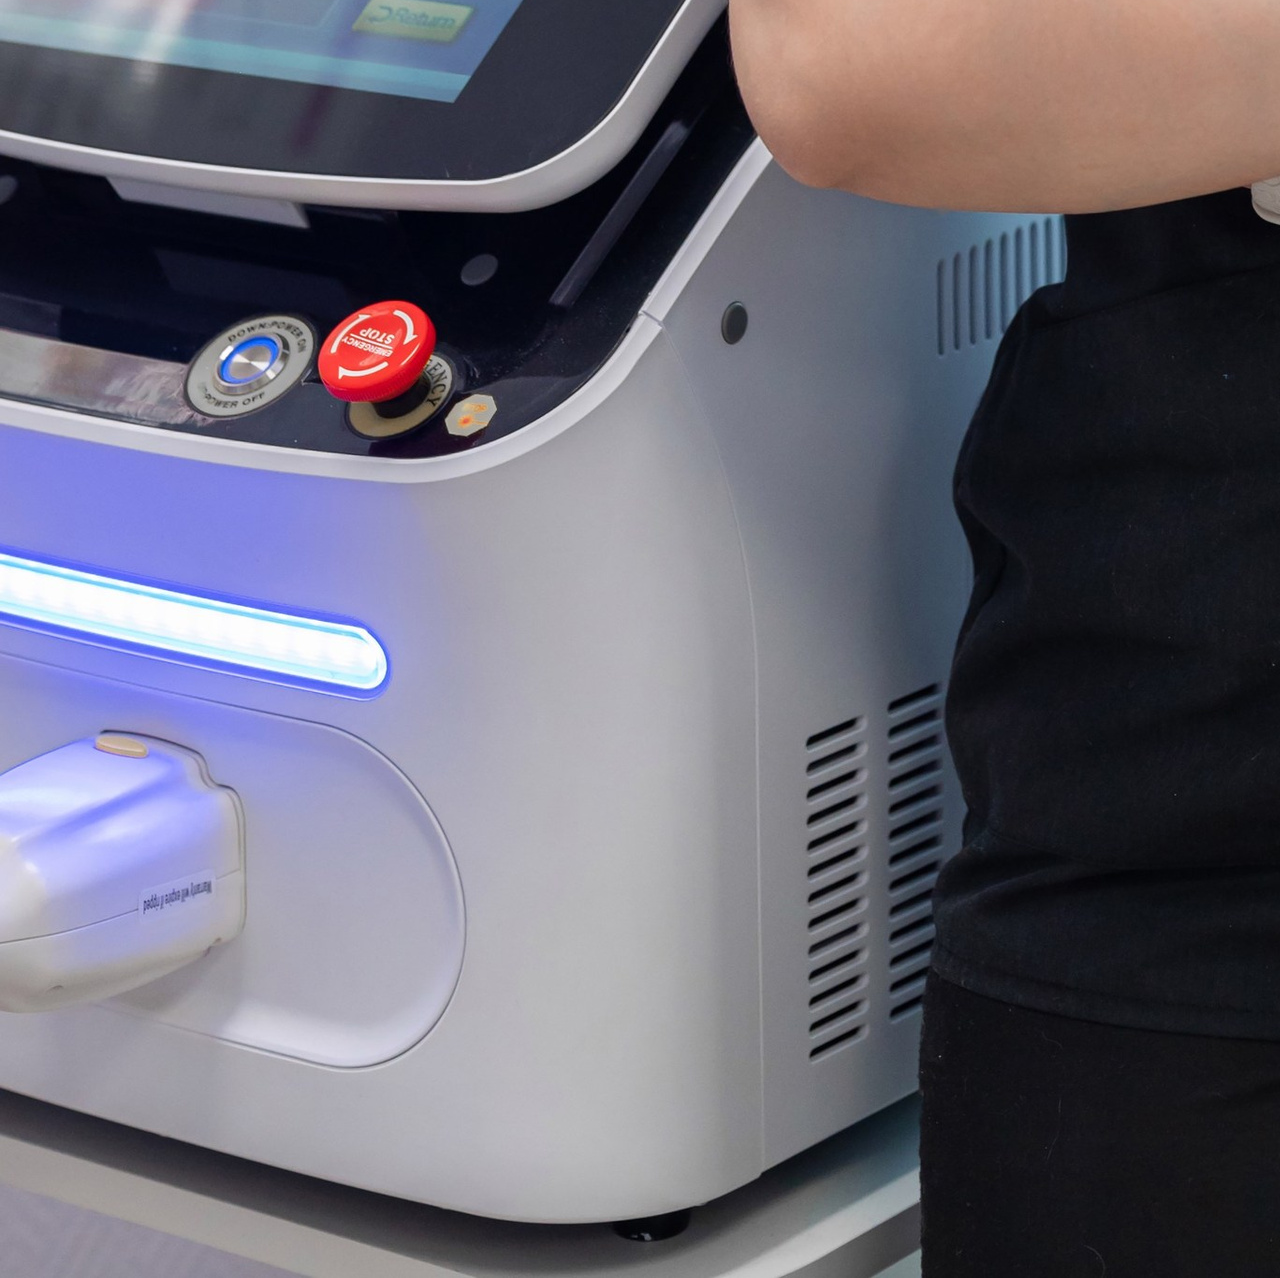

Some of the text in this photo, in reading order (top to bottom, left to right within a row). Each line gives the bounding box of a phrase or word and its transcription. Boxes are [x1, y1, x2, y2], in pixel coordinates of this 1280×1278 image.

[394, 6, 456, 30] Return
[359, 327, 395, 345] STOP
[341, 336, 393, 358] EMERGENCY
[242, 391, 265, 406] OFF
[143, 894, 160, 915] ripped
